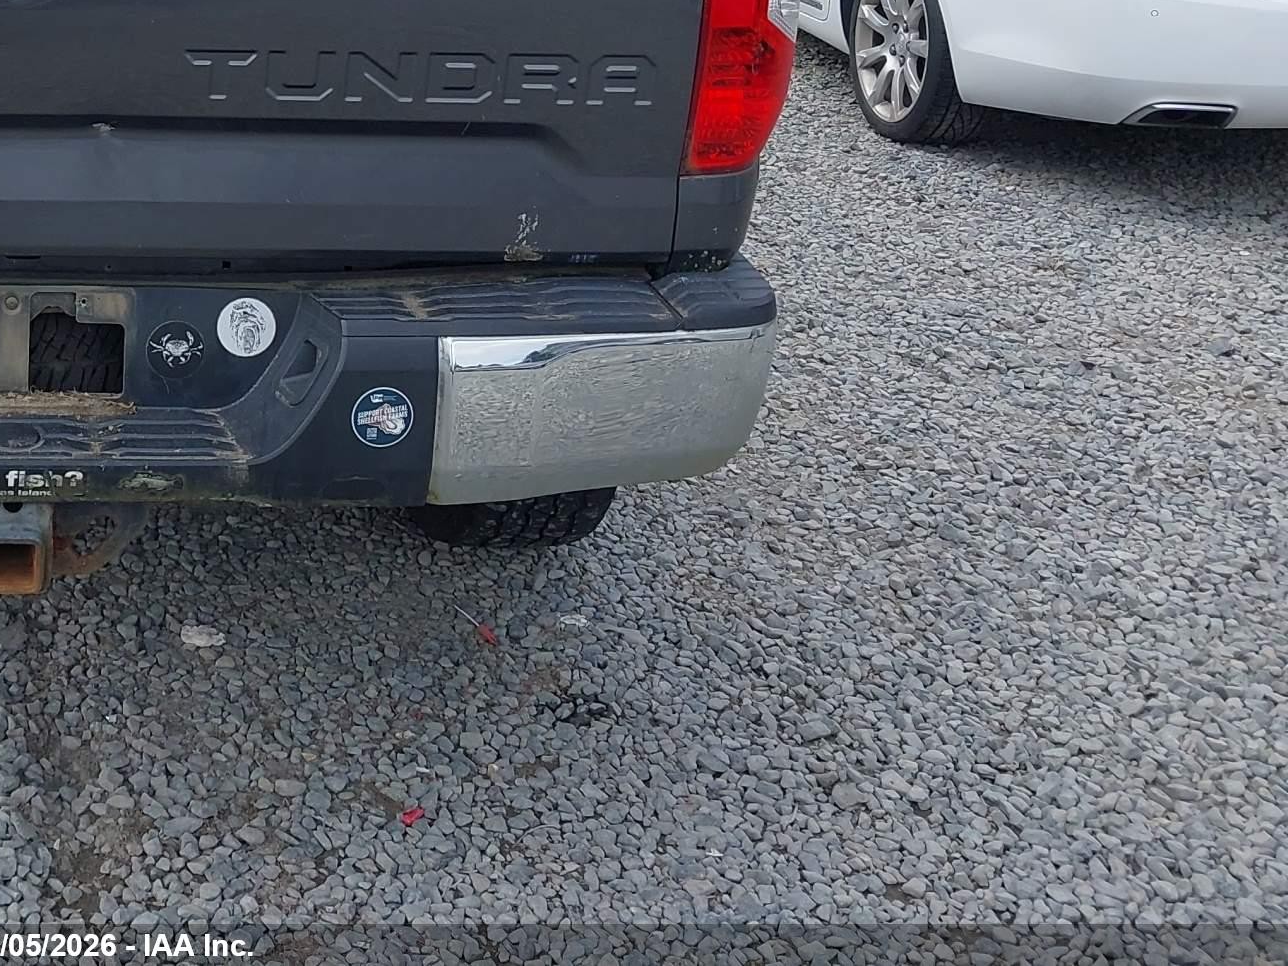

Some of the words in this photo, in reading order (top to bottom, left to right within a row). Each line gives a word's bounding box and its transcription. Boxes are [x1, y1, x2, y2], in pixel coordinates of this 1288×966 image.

[184, 49, 657, 106] TUNDRA
[357, 409, 383, 419] SUPPORT
[384, 404, 408, 414] COASTAL
[5, 470, 84, 488] fish?
